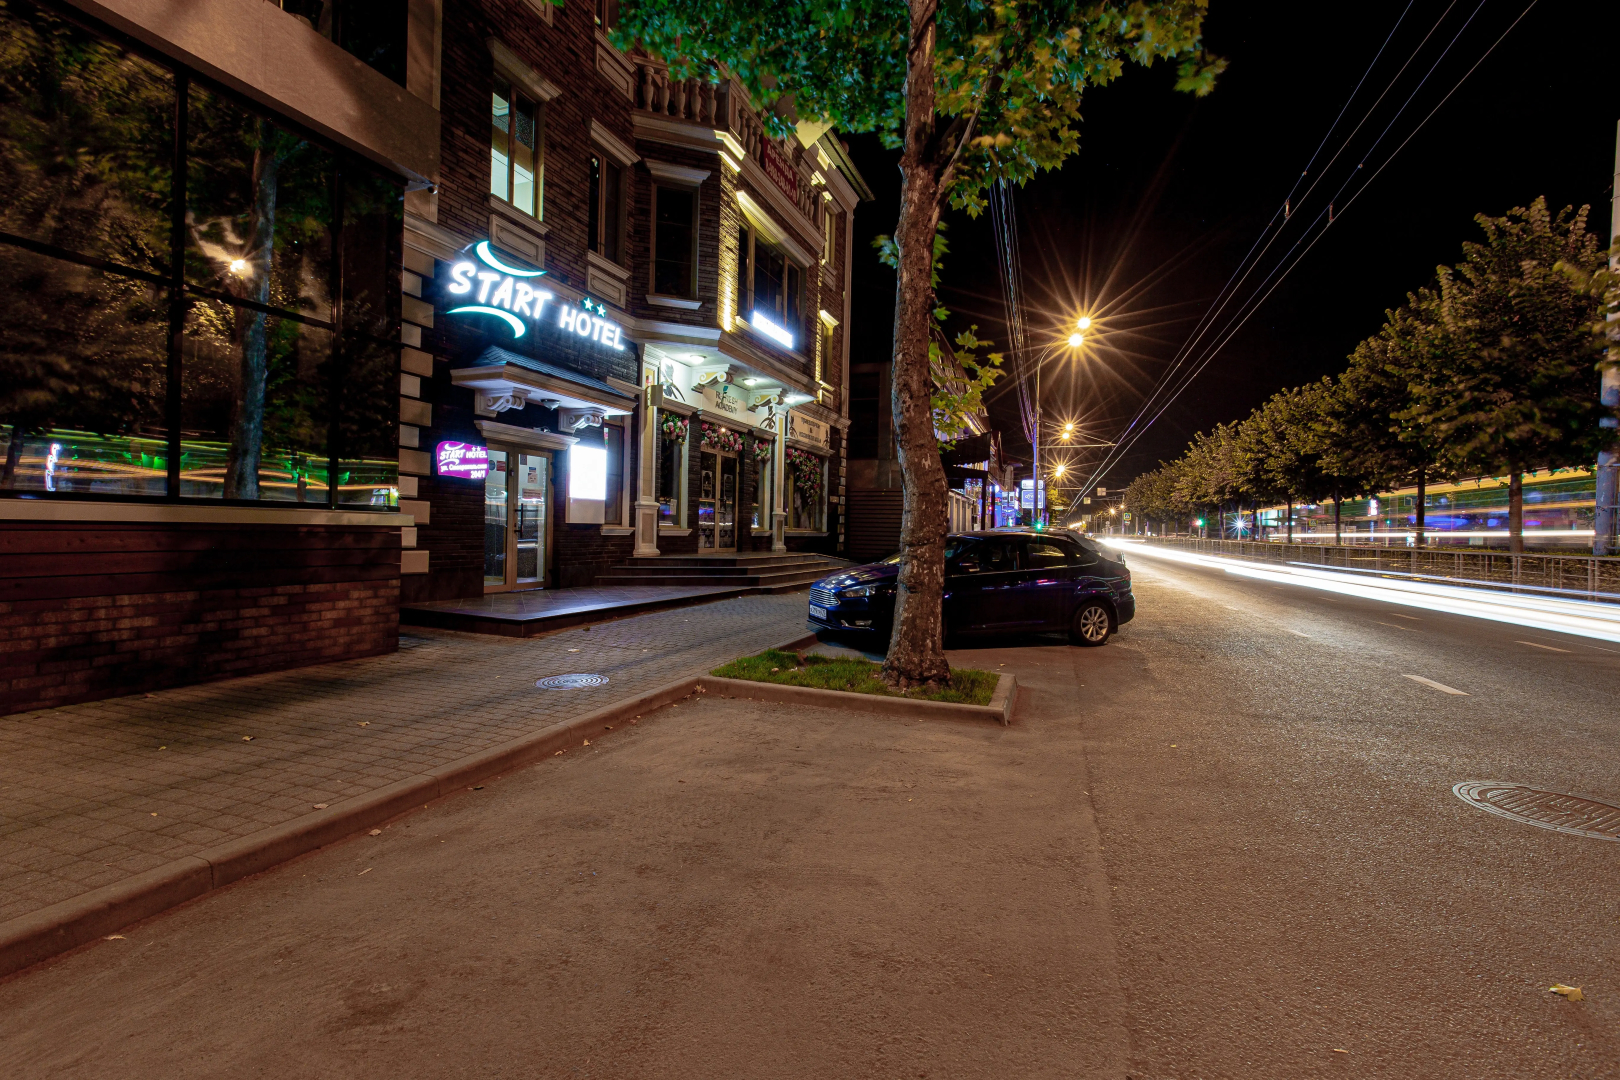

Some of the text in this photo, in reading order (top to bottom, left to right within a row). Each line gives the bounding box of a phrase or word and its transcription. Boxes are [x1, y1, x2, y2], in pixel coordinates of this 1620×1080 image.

[766, 144, 794, 181] АРЕНДА
[448, 262, 625, 351] START HOTEL
[439, 449, 488, 460] START HOTEL
